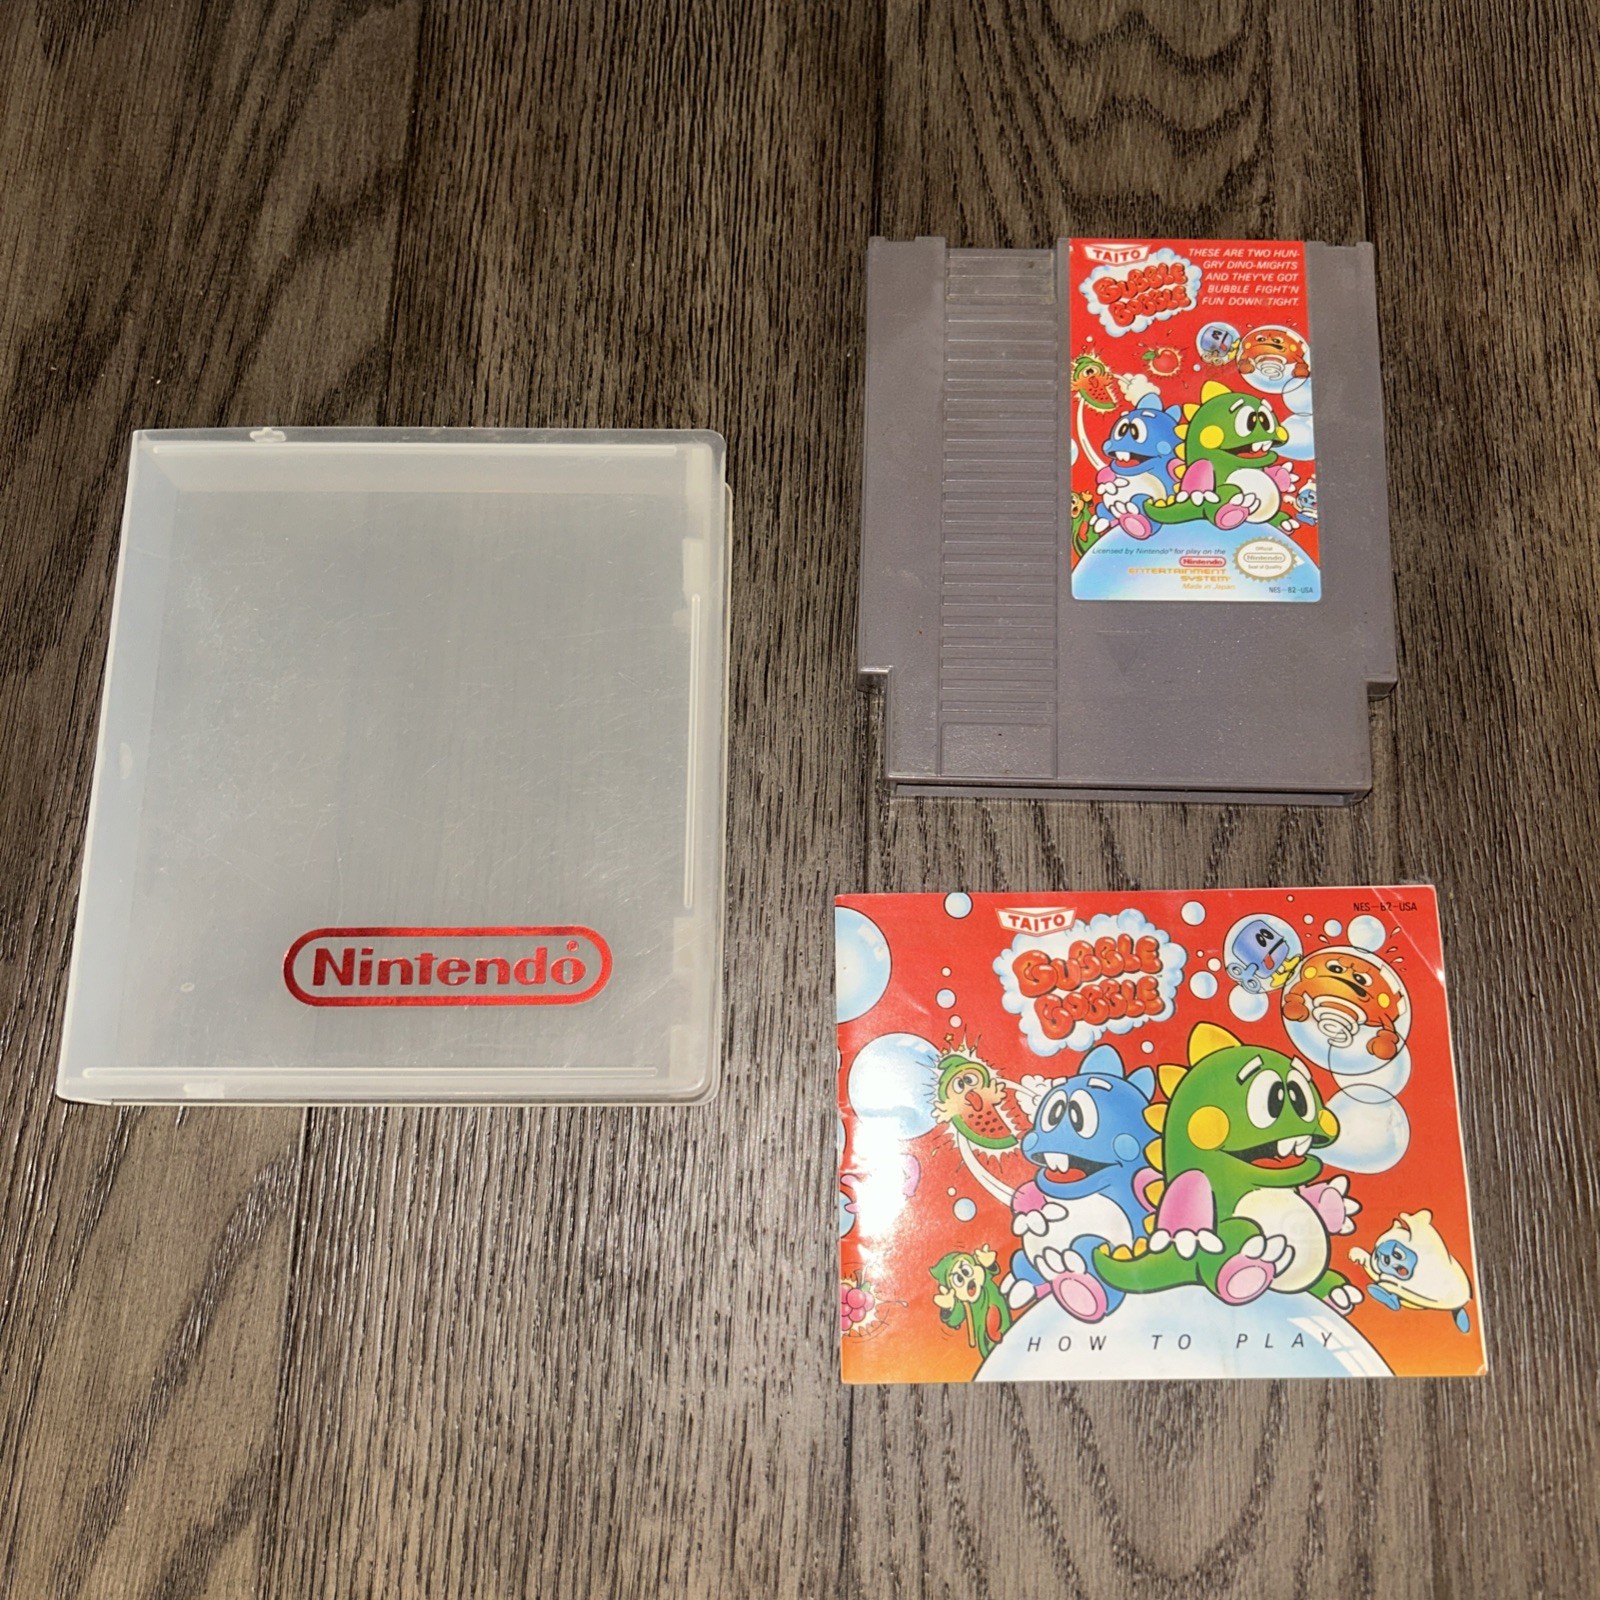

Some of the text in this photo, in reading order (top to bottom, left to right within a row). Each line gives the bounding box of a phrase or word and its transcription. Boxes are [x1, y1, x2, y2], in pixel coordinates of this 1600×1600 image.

[1092, 249, 1142, 262] TAITO
[1189, 248, 1300, 258] THESE ARE TWO HUN-
[1203, 260, 1298, 270] GRY DINO-MIGHTS
[1205, 272, 1299, 282] AND THEY'VE GOT
[1092, 262, 1189, 305] BUBBLE
[1207, 284, 1299, 294] BUBBLE FIGHT'N
[1108, 285, 1192, 327] BOBBLE
[1201, 297, 1299, 306] FUN DOWN TIGHT.
[1124, 548, 1134, 556] by
[1185, 548, 1201, 556] play
[1128, 567, 1227, 575] ENTERTAINMENT
[1214, 583, 1236, 591] Japan
[1008, 913, 1066, 932] TAITO
[1012, 933, 1163, 998] BUBBLE
[1034, 975, 1166, 1040] BOBBLE
[1026, 1331, 1333, 1352] HOW TO PLAY
